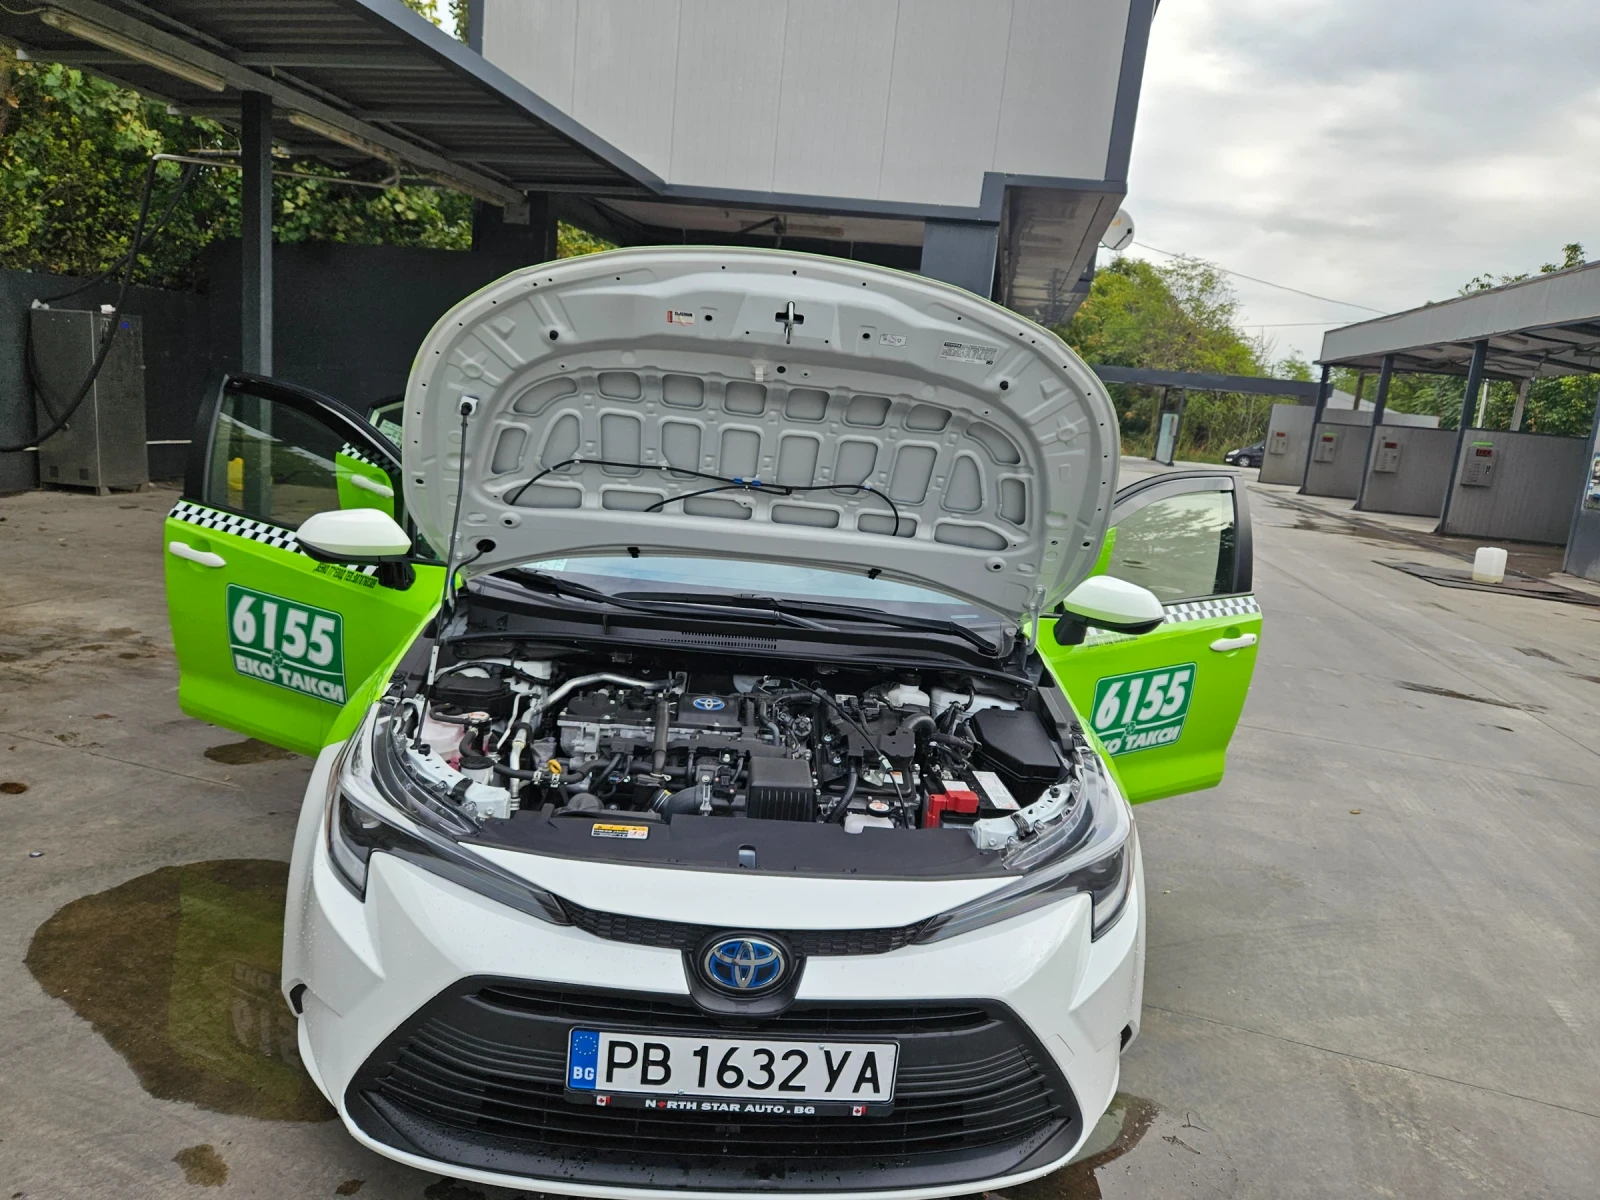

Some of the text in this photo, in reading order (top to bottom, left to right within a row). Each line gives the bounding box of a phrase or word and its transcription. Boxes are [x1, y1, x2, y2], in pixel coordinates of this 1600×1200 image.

[232, 594, 336, 667] 6155
[234, 653, 345, 703] ЕКО ТАКСИ
[1094, 669, 1191, 730] 6155
[1124, 724, 1182, 751] ТАКСИ
[572, 1065, 595, 1081] BG
[692, 1045, 809, 1093] 1632
[645, 1099, 697, 1110] NRTH
[701, 1102, 740, 1112] STAR
